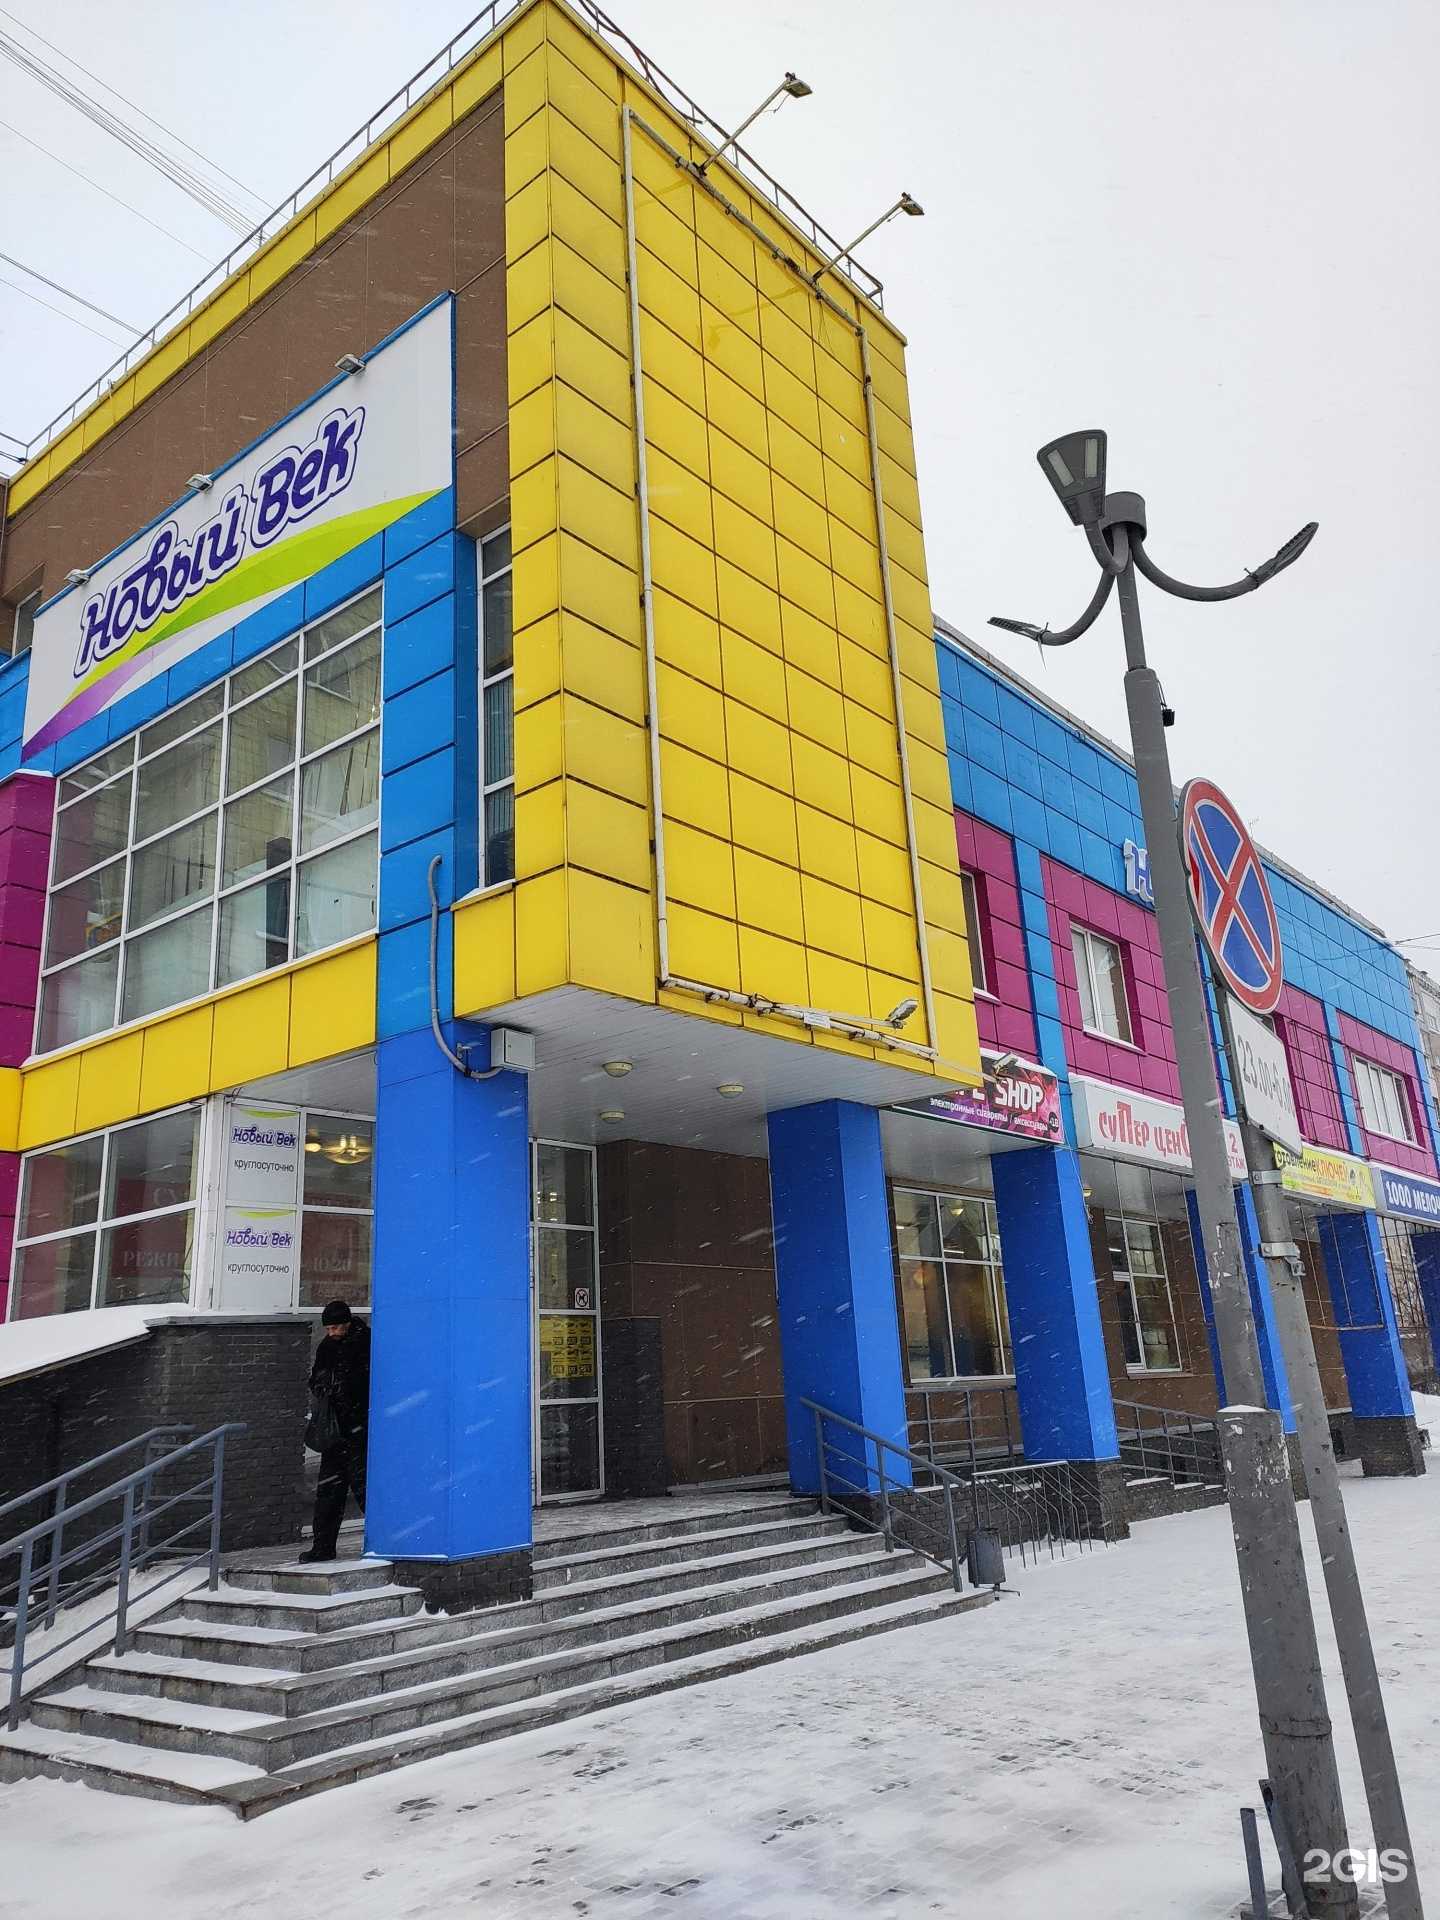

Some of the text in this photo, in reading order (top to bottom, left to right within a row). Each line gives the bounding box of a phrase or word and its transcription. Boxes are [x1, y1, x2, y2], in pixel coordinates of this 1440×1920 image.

[78, 418, 358, 667] Новый Век
[995, 1077, 1045, 1113] SHOP
[232, 1124, 297, 1147] Новый Век
[1229, 1132, 1239, 1153] 2
[234, 1158, 295, 1173] круглосуточно
[1385, 1180, 1413, 1208] 1000
[226, 1228, 292, 1247] Новый Век
[227, 1263, 290, 1275] круглосуточно
